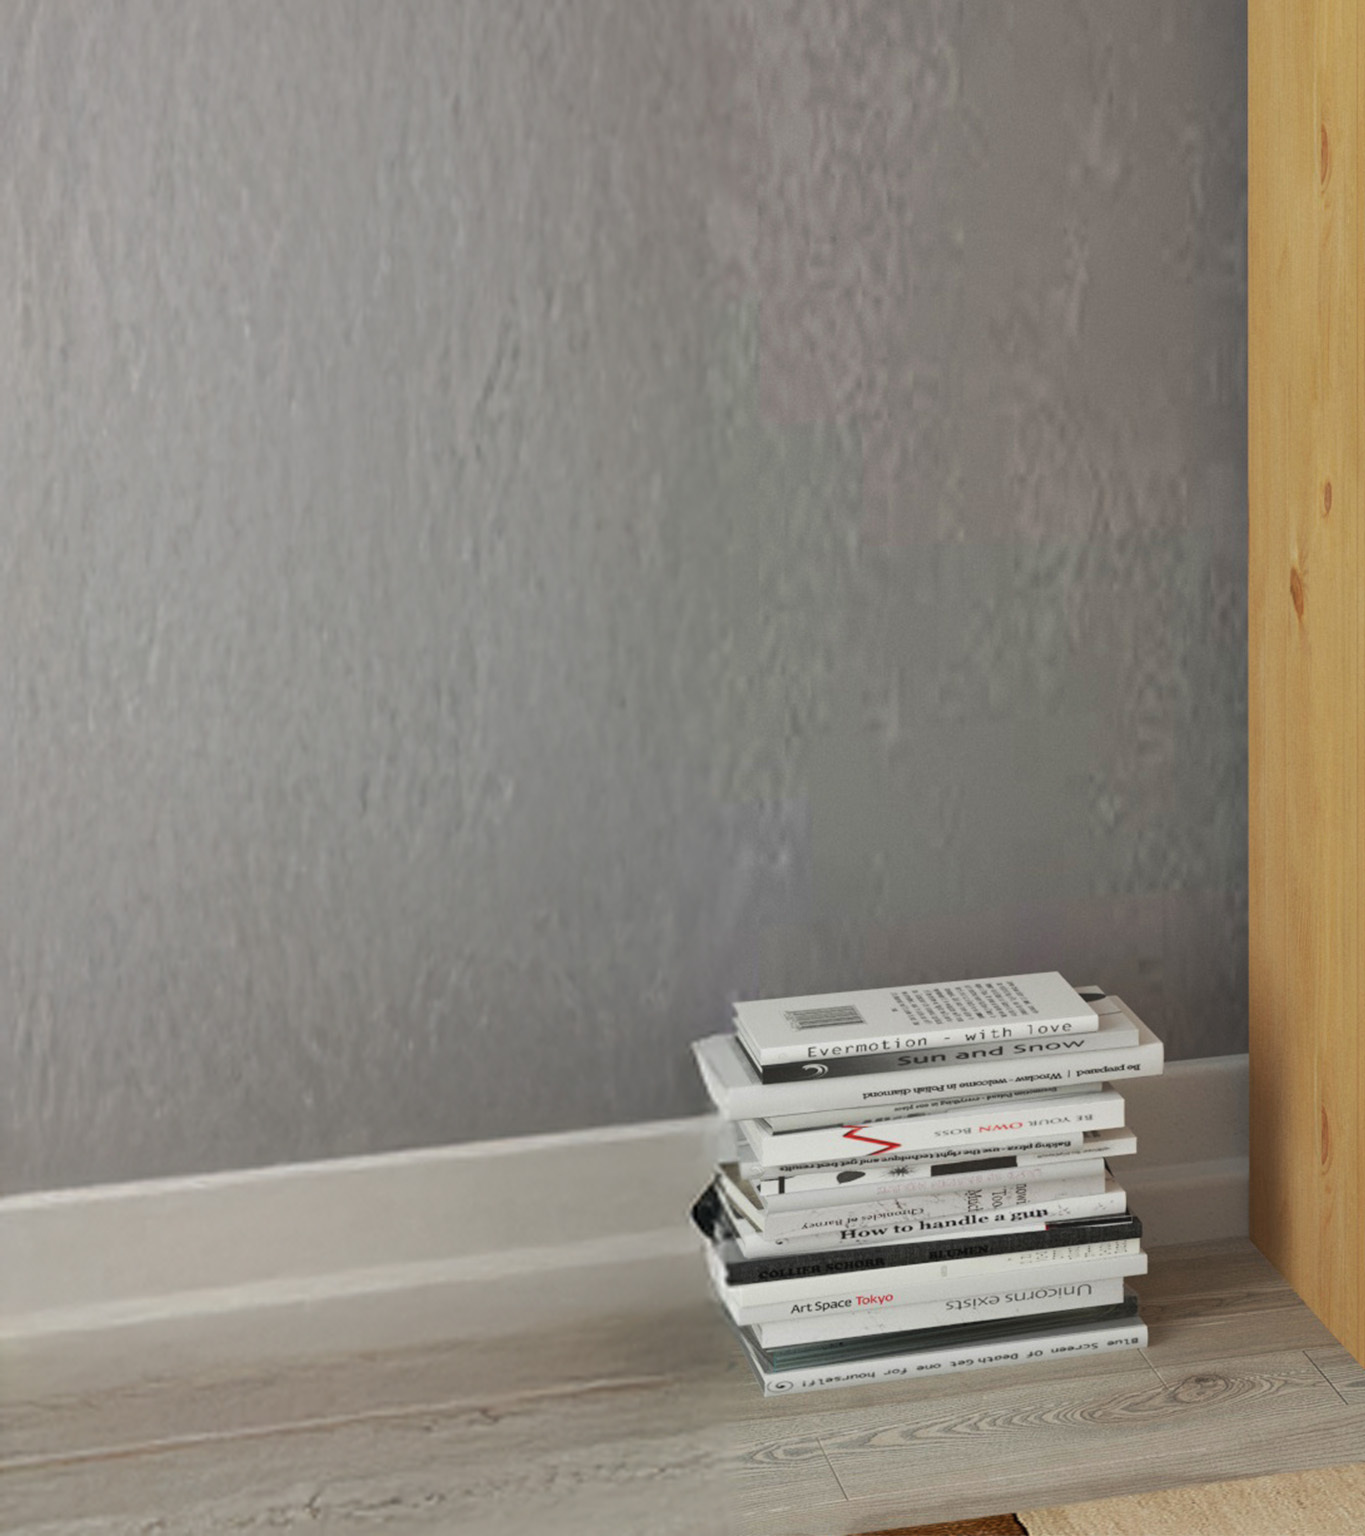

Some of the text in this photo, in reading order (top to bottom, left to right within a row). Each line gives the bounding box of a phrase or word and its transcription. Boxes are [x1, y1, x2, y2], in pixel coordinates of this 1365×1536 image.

[807, 1022, 1072, 1058] Evermotion with love
[898, 1039, 1085, 1066] Sun and Snow
[978, 1121, 1024, 1133] OWN
[840, 1226, 888, 1240] How
[893, 1224, 914, 1234] to
[919, 1214, 989, 1231] handle
[994, 1214, 1005, 1222] a
[790, 1293, 894, 1315] Art Space Tokyo
[945, 1283, 1093, 1311] Unicorns exists
